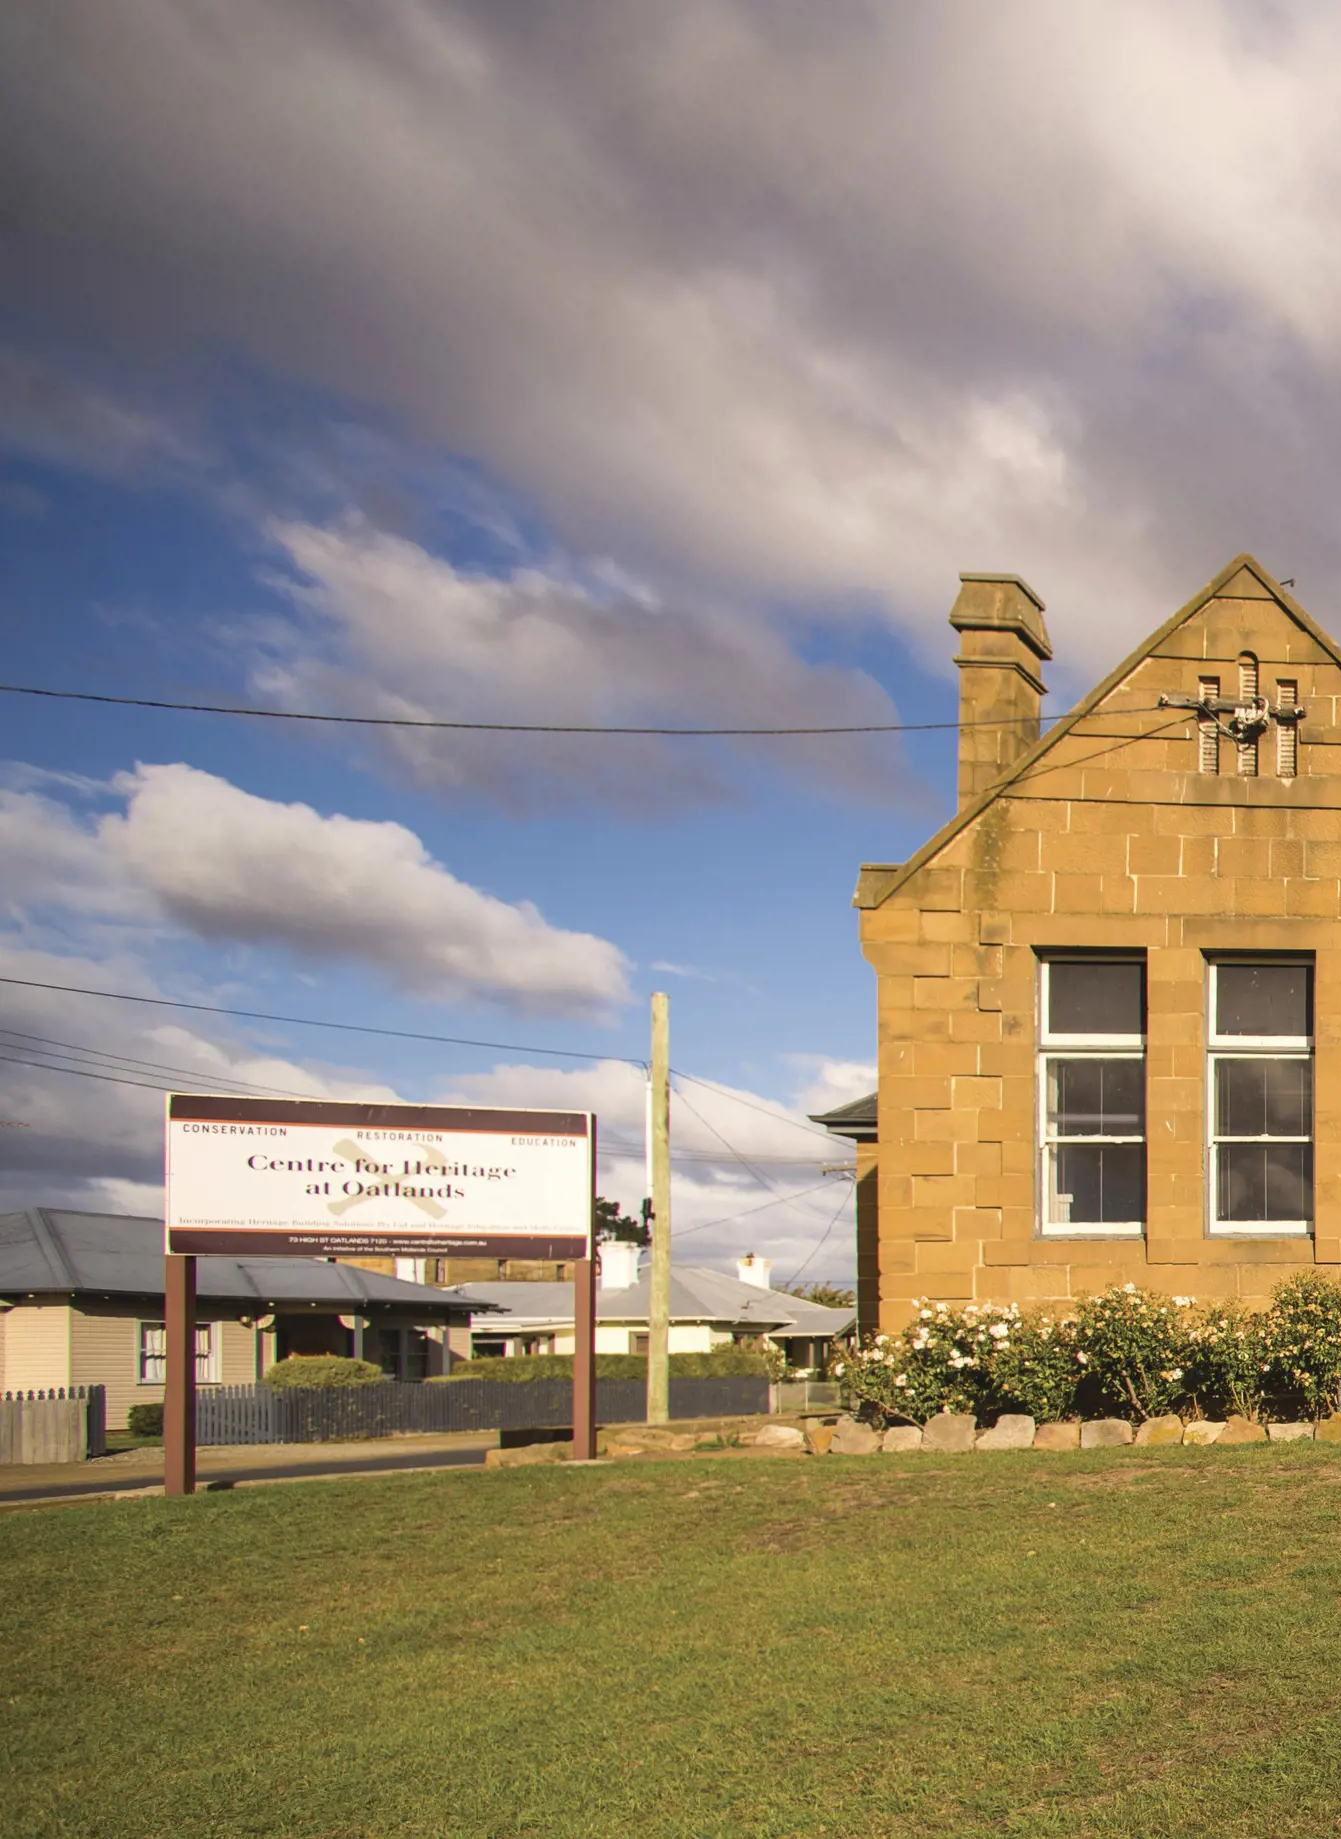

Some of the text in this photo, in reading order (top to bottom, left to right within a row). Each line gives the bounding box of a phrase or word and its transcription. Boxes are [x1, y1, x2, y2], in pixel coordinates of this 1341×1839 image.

[183, 1123, 288, 1137] CONSERVATION
[357, 1131, 443, 1143] RESTORATION
[511, 1137, 577, 1148] EDUCATION
[248, 1154, 517, 1180] Centre for Heritage
[305, 1180, 465, 1198] at Oatlands
[178, 1217, 246, 1226] Incorporating
[299, 1236, 319, 1244] HIGH
[319, 1236, 329, 1244] ST
[330, 1237, 369, 1245] OATLANDS
